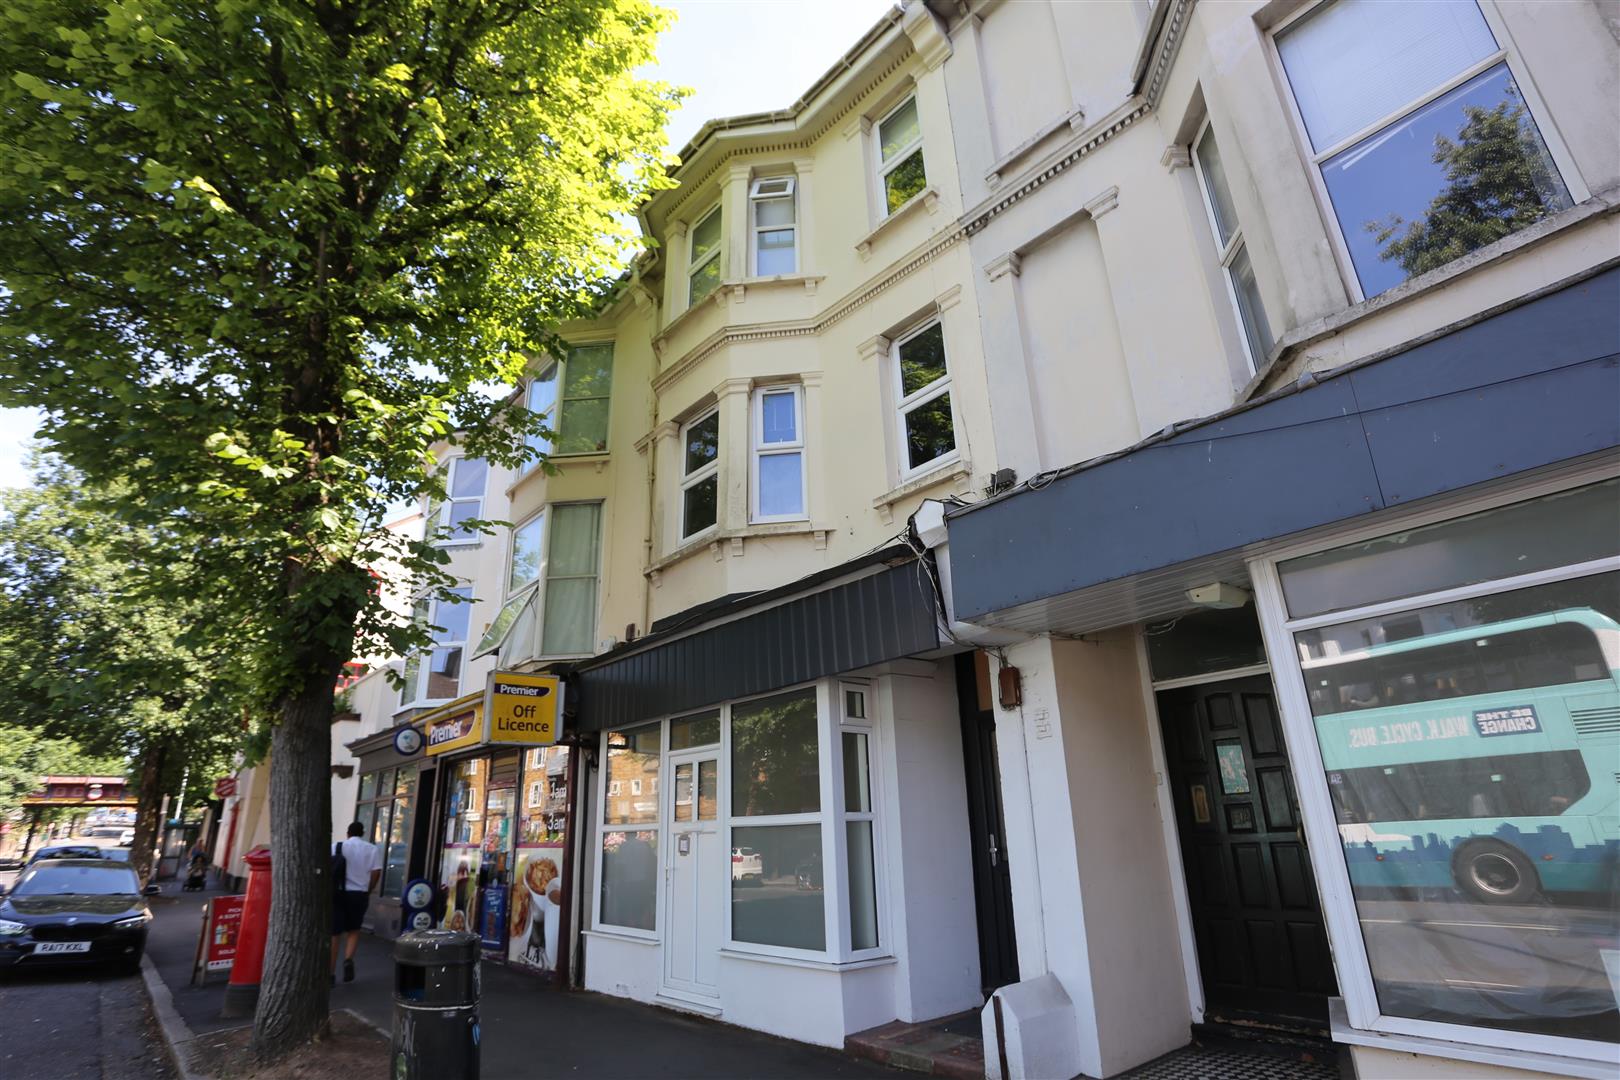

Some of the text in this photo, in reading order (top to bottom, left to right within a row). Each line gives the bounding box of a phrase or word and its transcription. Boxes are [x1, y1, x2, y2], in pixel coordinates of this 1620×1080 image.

[500, 684, 539, 696] Premier
[513, 704, 537, 718] Off
[498, 717, 549, 732] Licence
[430, 720, 462, 745] Premier
